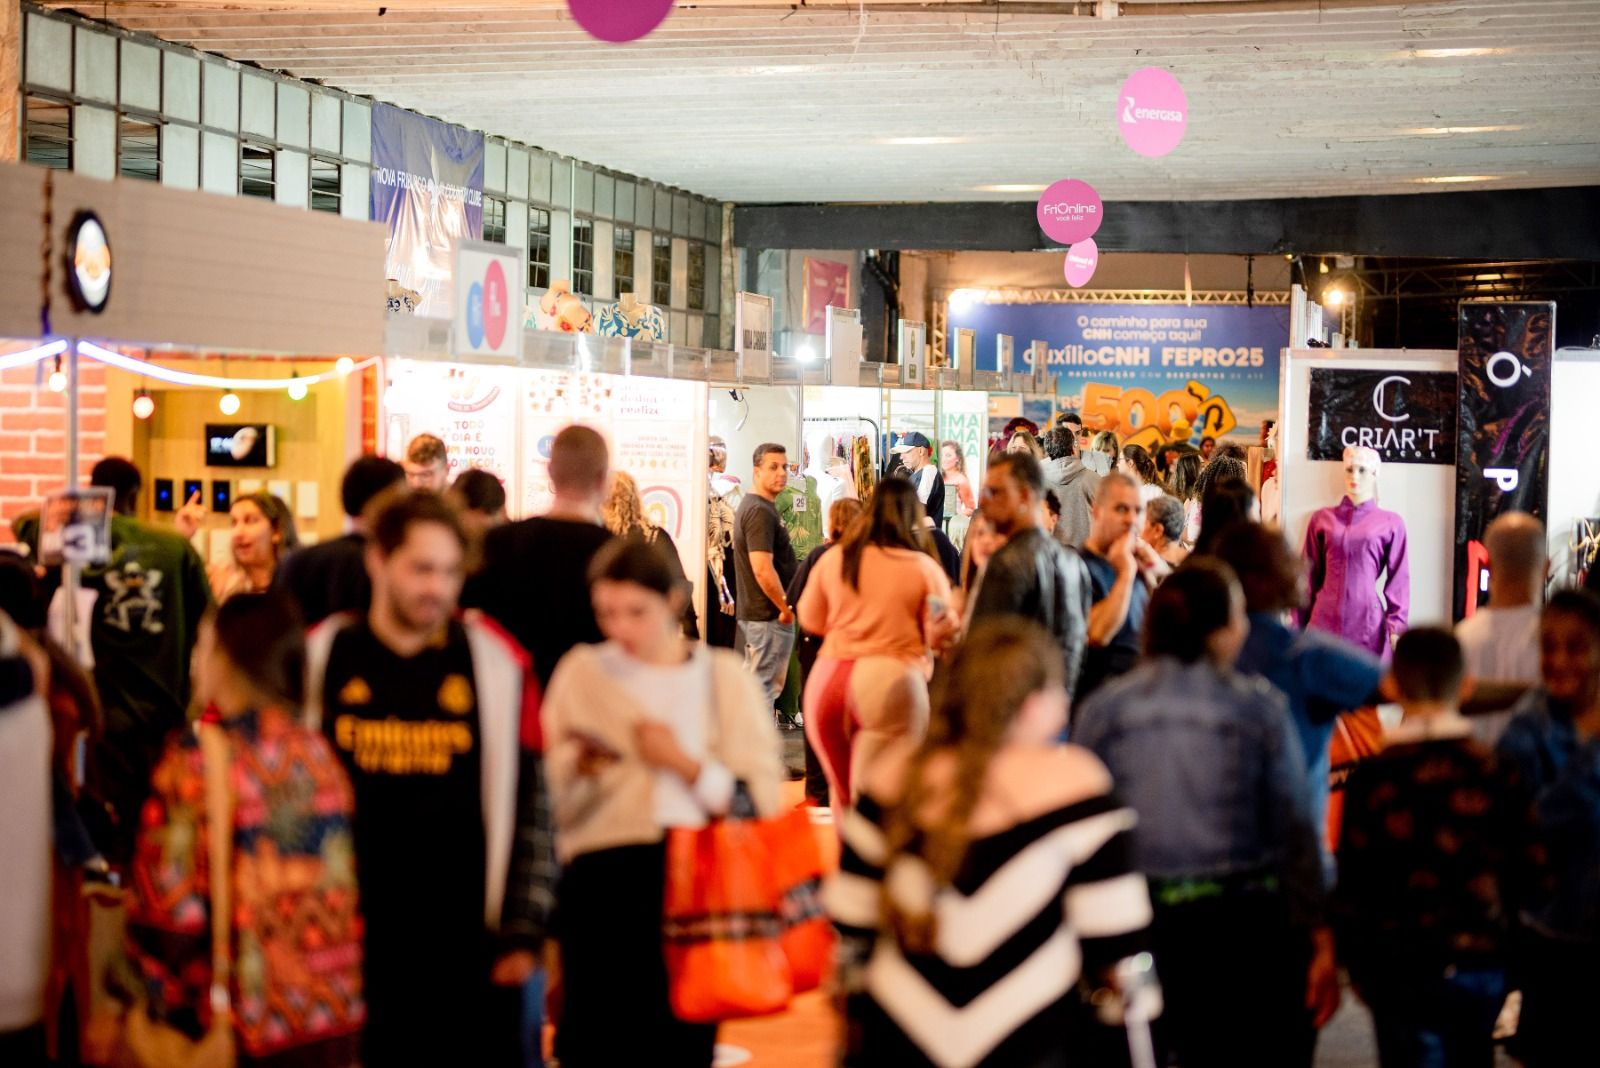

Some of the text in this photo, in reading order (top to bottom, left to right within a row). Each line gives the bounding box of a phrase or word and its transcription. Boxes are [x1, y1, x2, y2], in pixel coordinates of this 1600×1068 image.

[1135, 107, 1183, 122] energisa
[377, 167, 397, 187] NOVA
[1044, 202, 1097, 215] FriOnline
[1077, 315, 1207, 331] O caminho para sua
[1082, 327, 1113, 340] CNH
[1161, 346, 1264, 367] FEPRO25
[1082, 382, 1201, 437] 500
